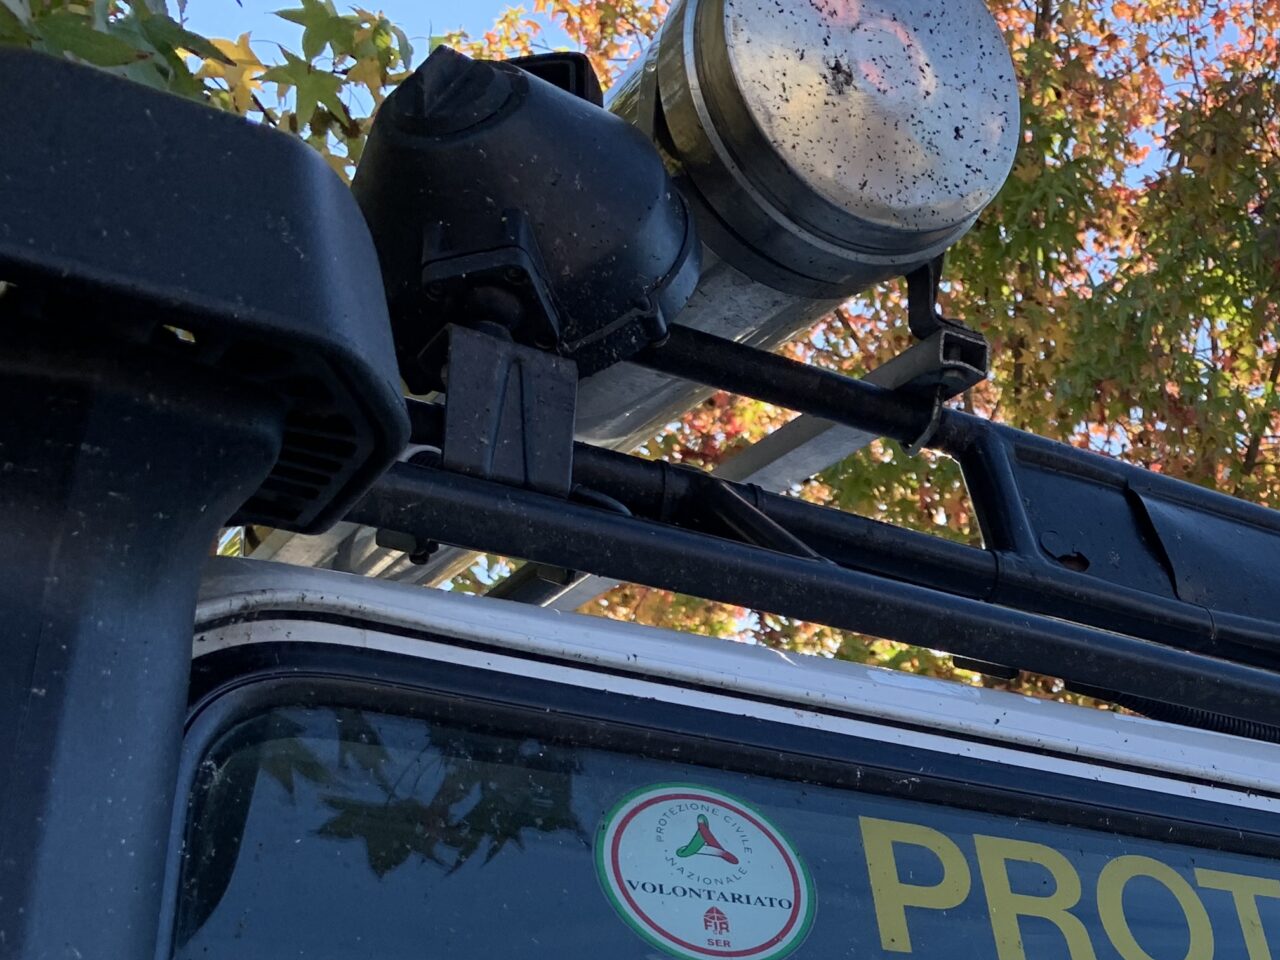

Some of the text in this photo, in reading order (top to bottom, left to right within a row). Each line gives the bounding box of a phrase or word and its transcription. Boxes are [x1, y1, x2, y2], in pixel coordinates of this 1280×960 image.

[656, 803, 753, 854] PROTEZIONE CIVILE
[664, 854, 749, 886] NAZIONALE
[626, 879, 793, 910] VOLONTARIATO
[706, 938, 731, 948] SER
